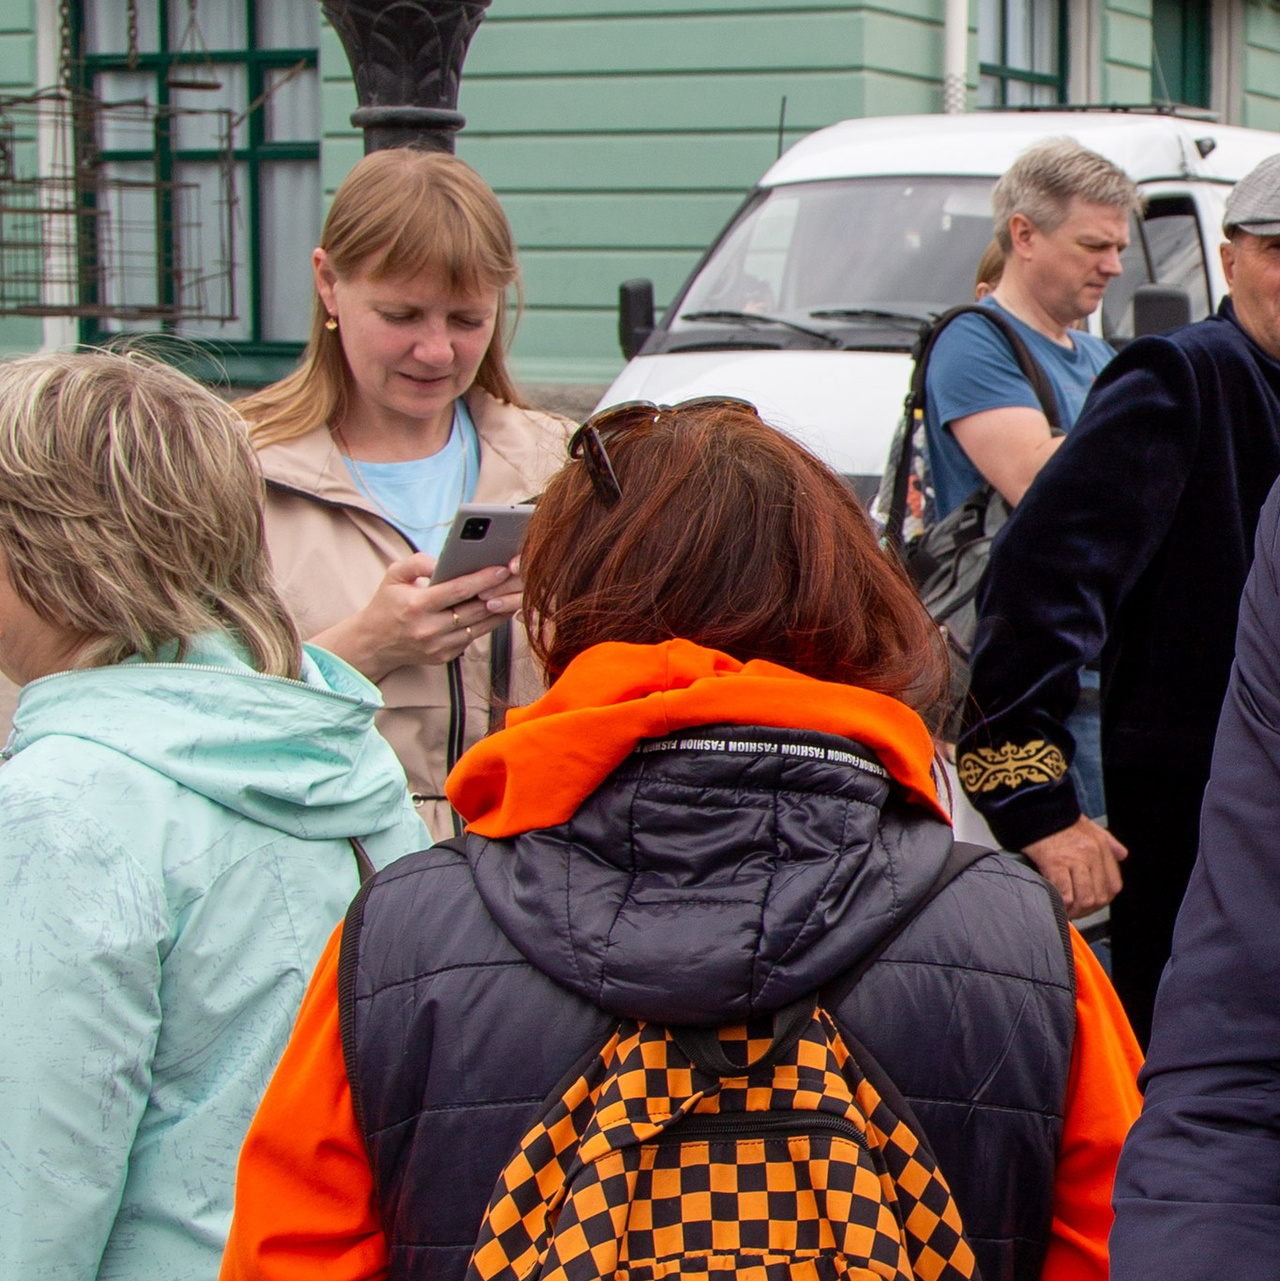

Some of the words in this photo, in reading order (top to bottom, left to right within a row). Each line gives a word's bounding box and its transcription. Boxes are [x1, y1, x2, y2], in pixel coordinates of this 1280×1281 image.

[680, 738, 725, 751] FASHION
[728, 740, 778, 753] FASHION
[781, 743, 825, 759] FASHION
